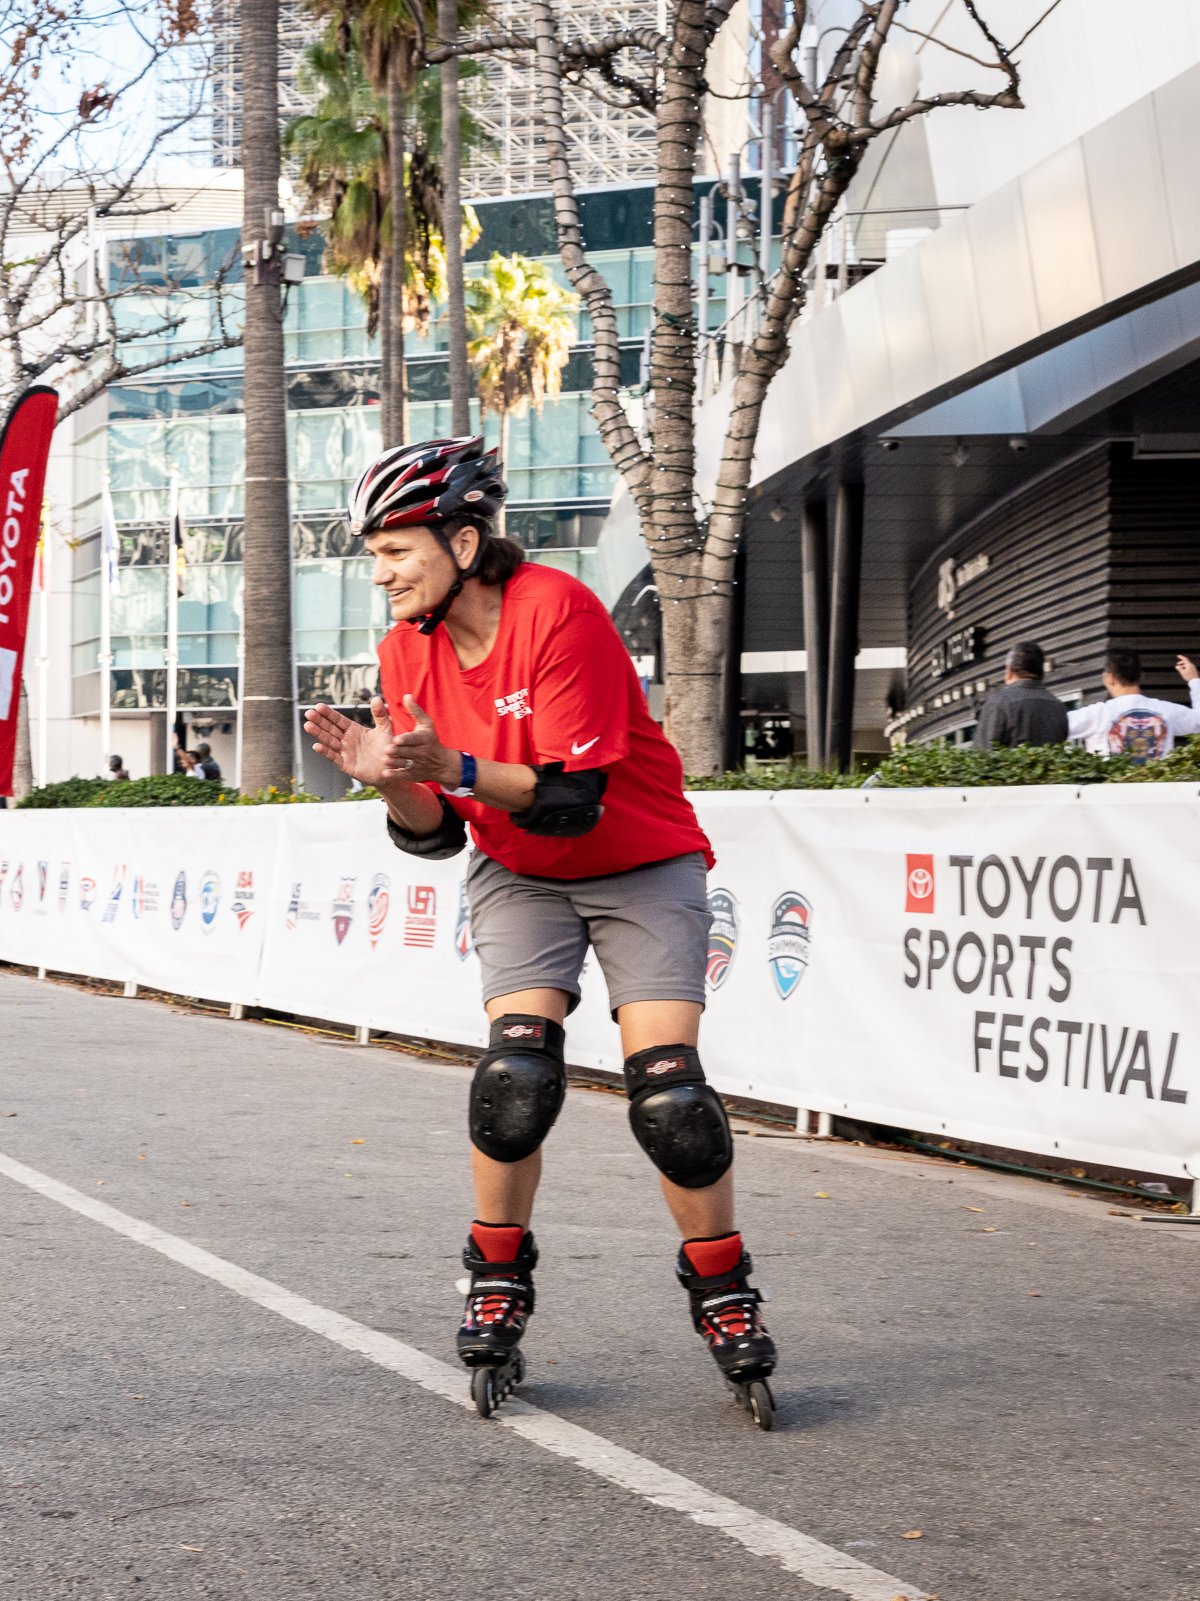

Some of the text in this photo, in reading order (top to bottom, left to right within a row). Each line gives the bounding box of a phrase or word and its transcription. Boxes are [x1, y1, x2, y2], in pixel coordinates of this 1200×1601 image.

[949, 854, 1147, 926] TOYOTA
[904, 927, 1074, 1003] SPORTS
[974, 1010, 1189, 1105] FESTIVAL
